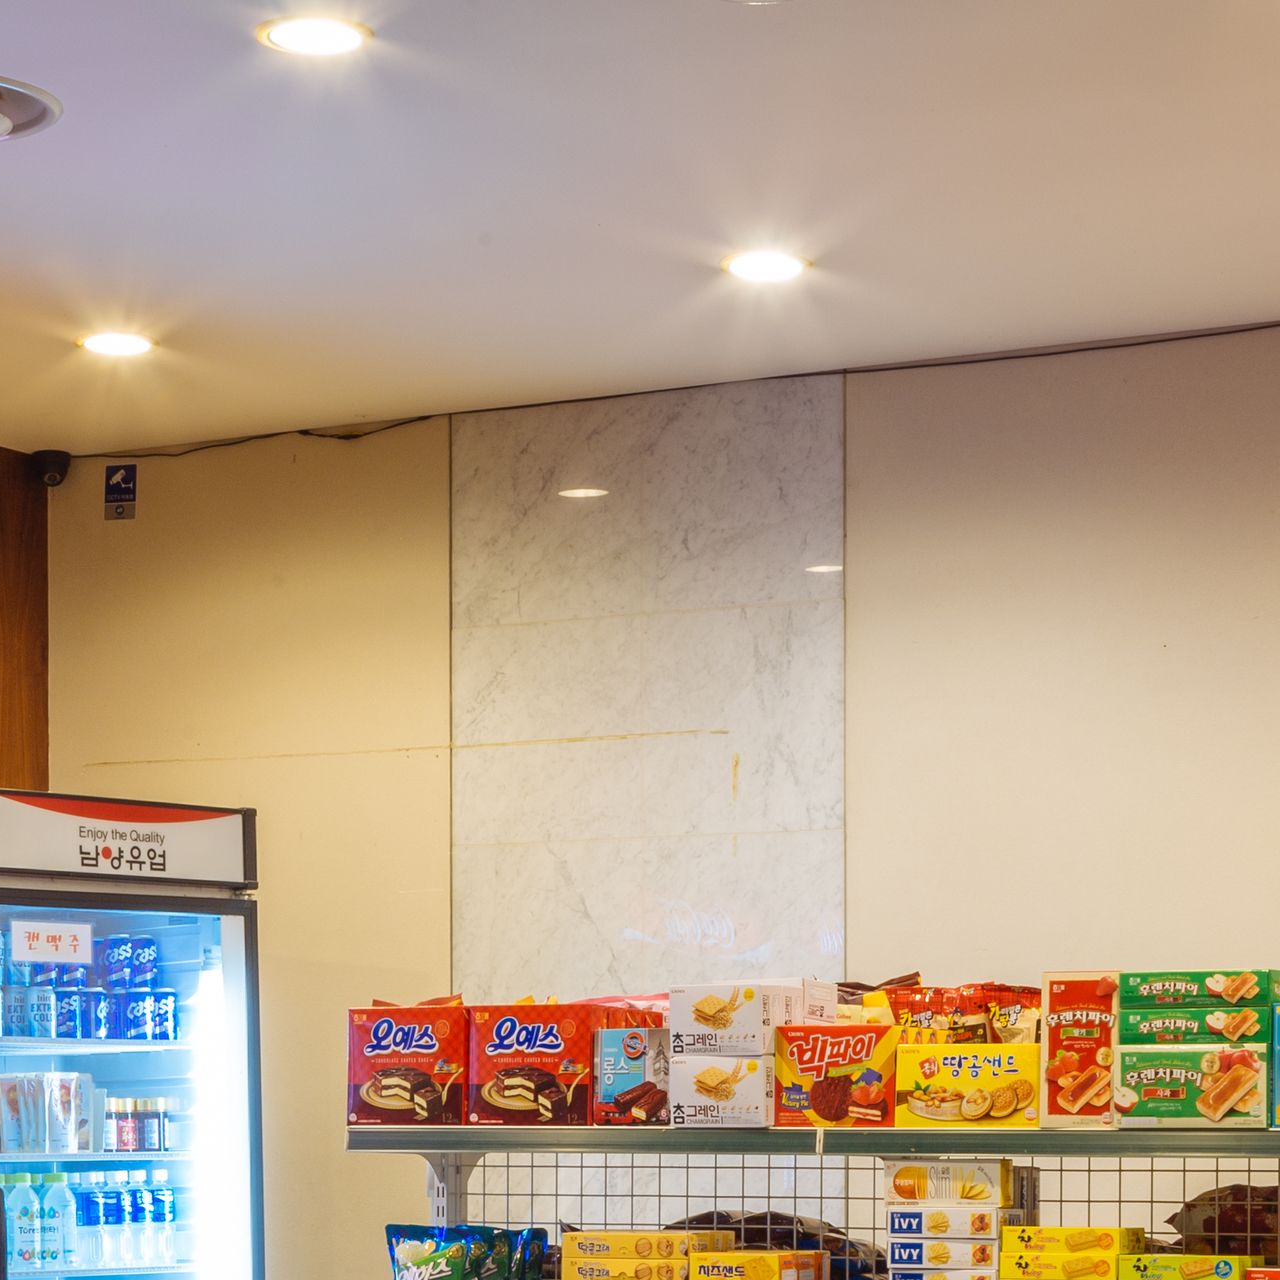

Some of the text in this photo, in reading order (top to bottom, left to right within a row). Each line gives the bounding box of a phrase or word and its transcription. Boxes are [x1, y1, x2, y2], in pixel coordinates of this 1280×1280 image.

[79, 826, 166, 846] Enjoy the Quality
[79, 845, 166, 872] 남양유업
[1138, 981, 1199, 996] 후렌치파이
[1046, 1010, 1116, 1028] 후렌치파이
[1138, 1018, 1200, 1034] 후렌치파이
[363, 1017, 439, 1056] 오예스
[485, 1016, 564, 1056] 오예스
[672, 1031, 718, 1055] 참그레인
[788, 1033, 877, 1082] 빅파이
[942, 1054, 1020, 1078] 땅콩샌드
[602, 1056, 630, 1085] 롱스
[1125, 1066, 1203, 1087] 후렌치파이
[672, 1105, 720, 1125] 참그레인
[893, 1217, 919, 1231] IVY
[894, 1247, 920, 1261] IVY
[697, 1265, 746, 1278] 치즈샌드
